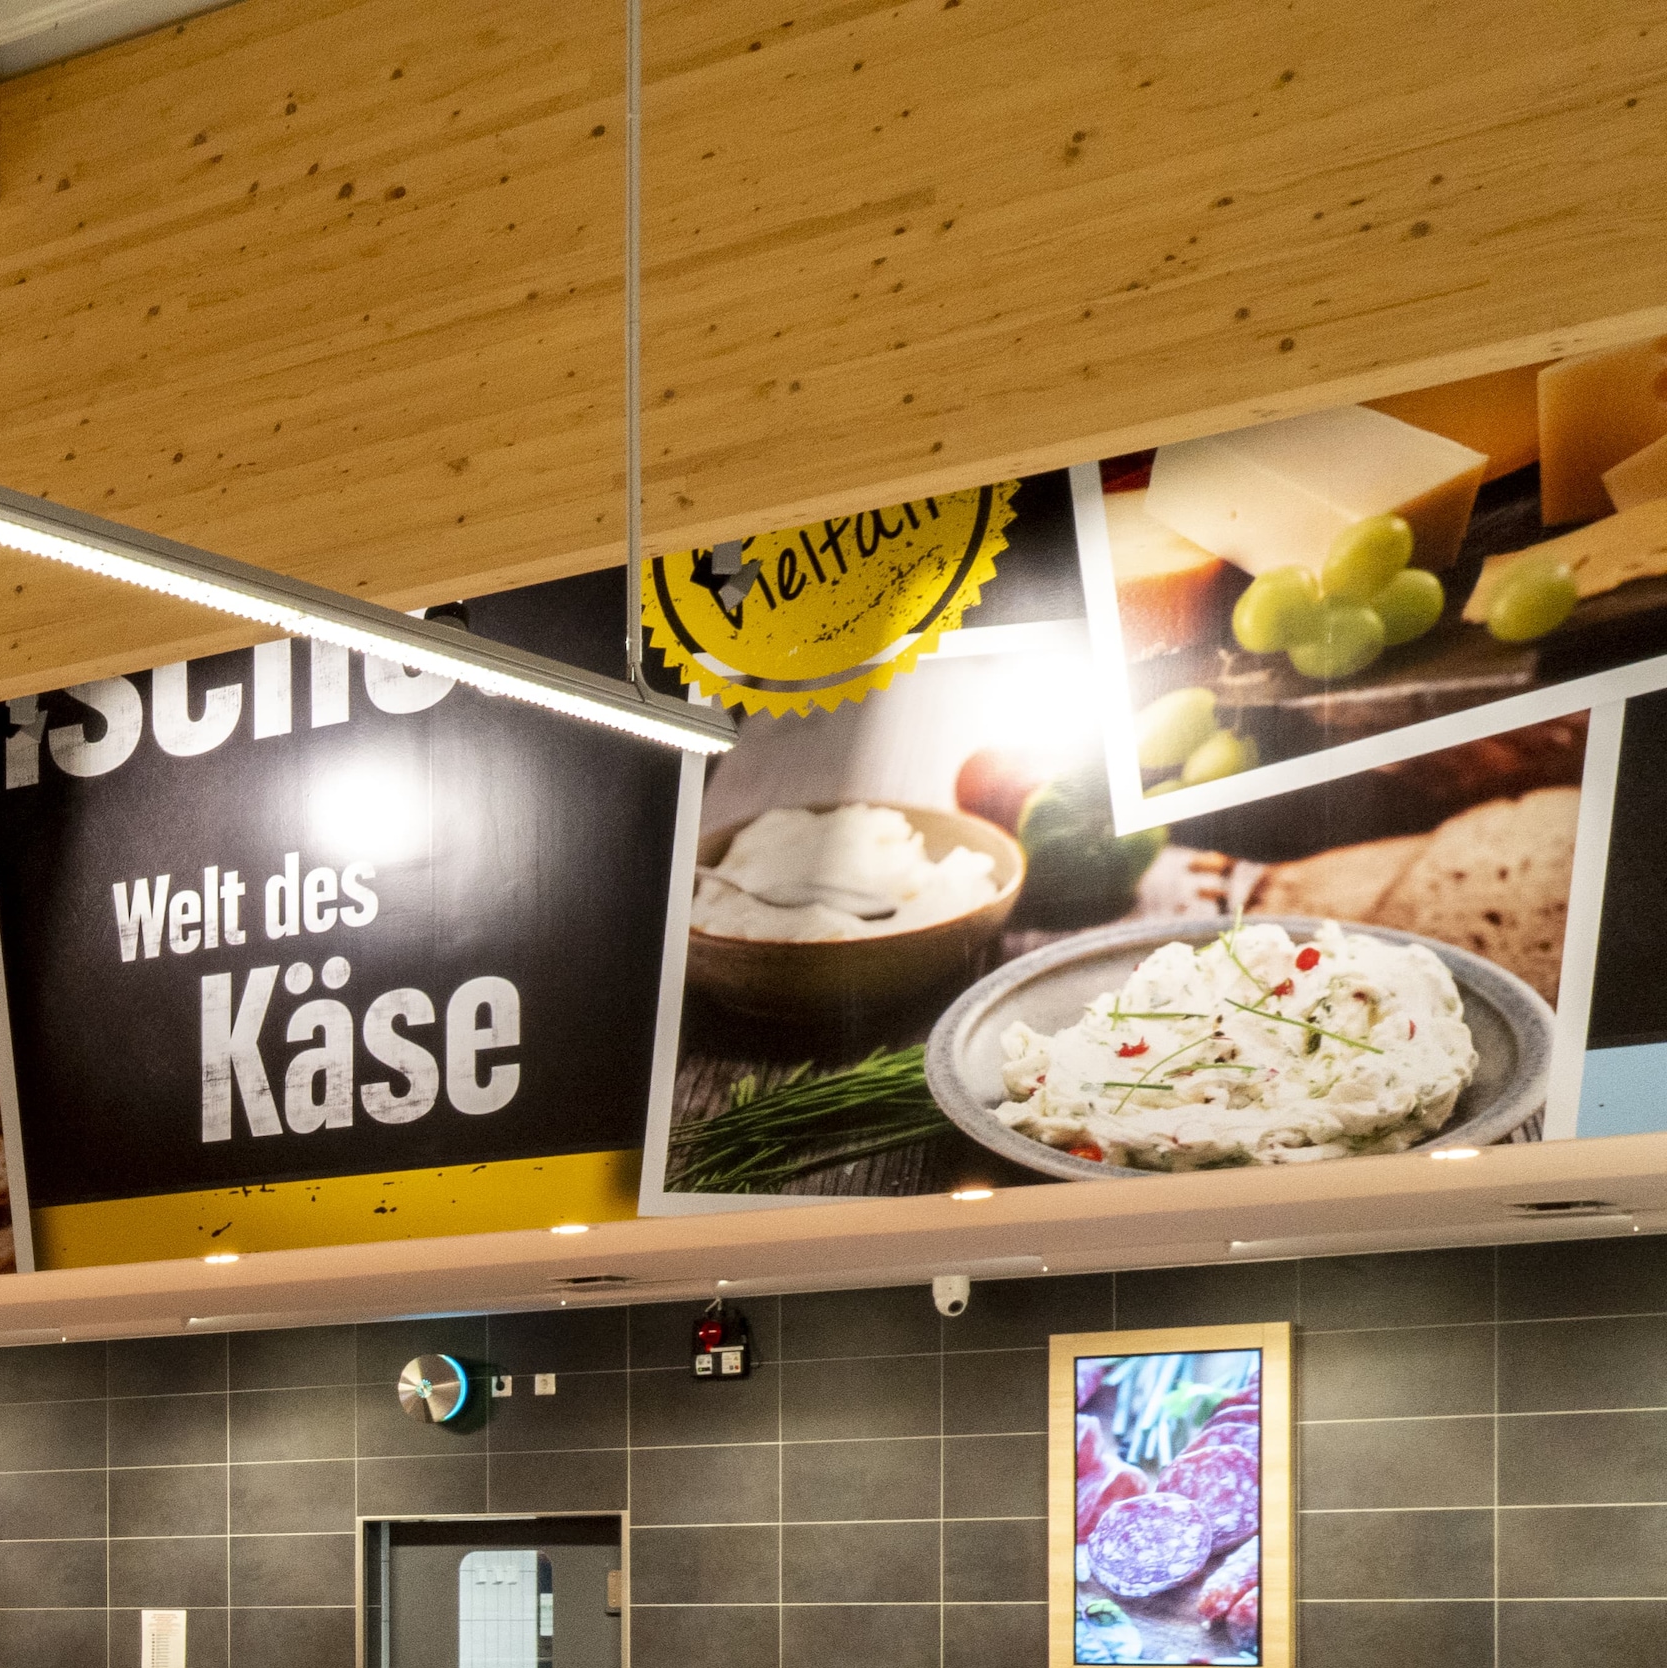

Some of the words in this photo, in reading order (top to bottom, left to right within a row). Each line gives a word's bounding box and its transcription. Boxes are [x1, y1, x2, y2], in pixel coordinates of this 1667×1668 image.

[112, 865, 245, 962] Welt
[265, 851, 380, 941] des
[201, 955, 521, 1144] Käse
